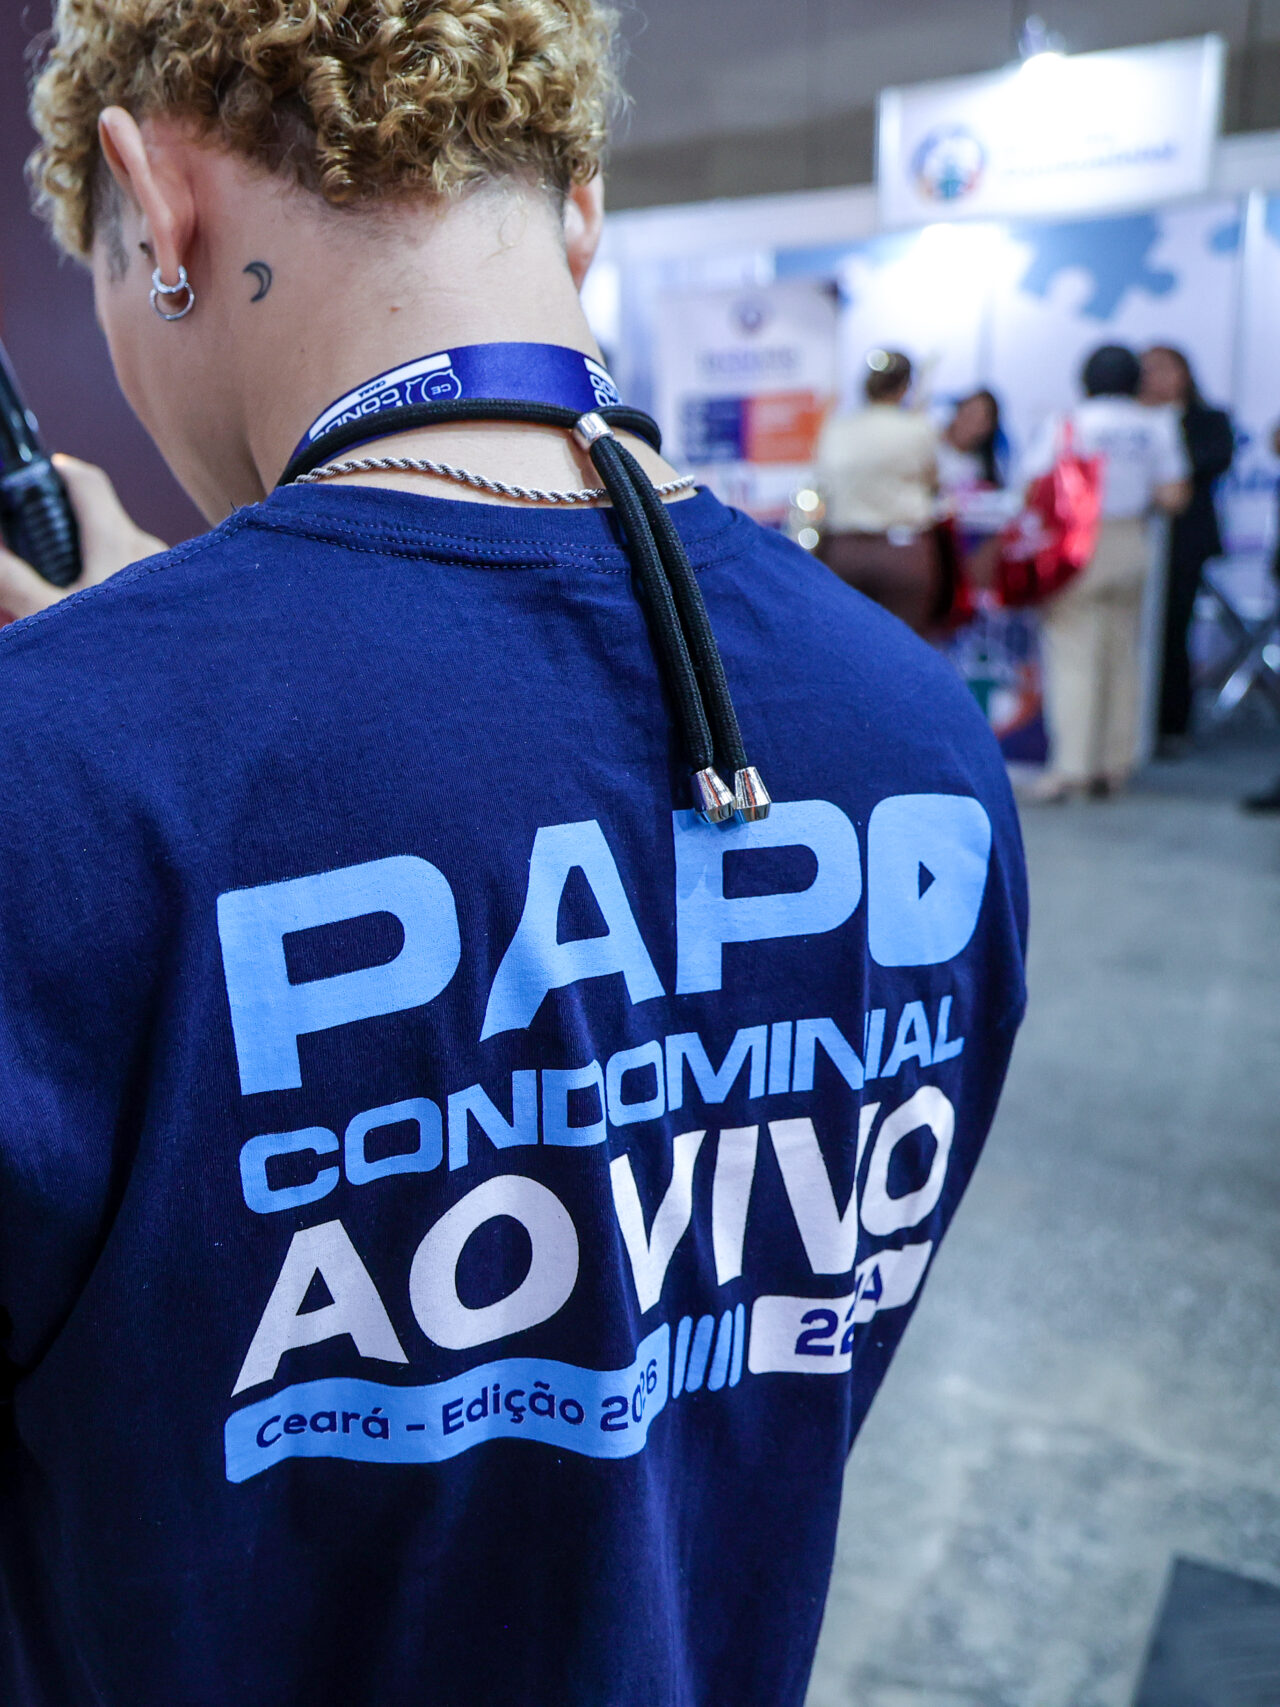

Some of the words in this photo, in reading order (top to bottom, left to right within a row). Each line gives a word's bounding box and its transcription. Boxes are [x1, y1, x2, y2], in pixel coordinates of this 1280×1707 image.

[312, 388, 400, 441] COND
[358, 380, 387, 398] CEARÁ
[430, 383, 452, 395] CE
[216, 793, 992, 1096] PAPO
[238, 995, 965, 1214] CONDOMINIAL
[231, 1174, 580, 1398] AO
[609, 1085, 955, 1315] VIVO
[256, 1407, 389, 1449] Ceará
[442, 1380, 585, 1436] Edição
